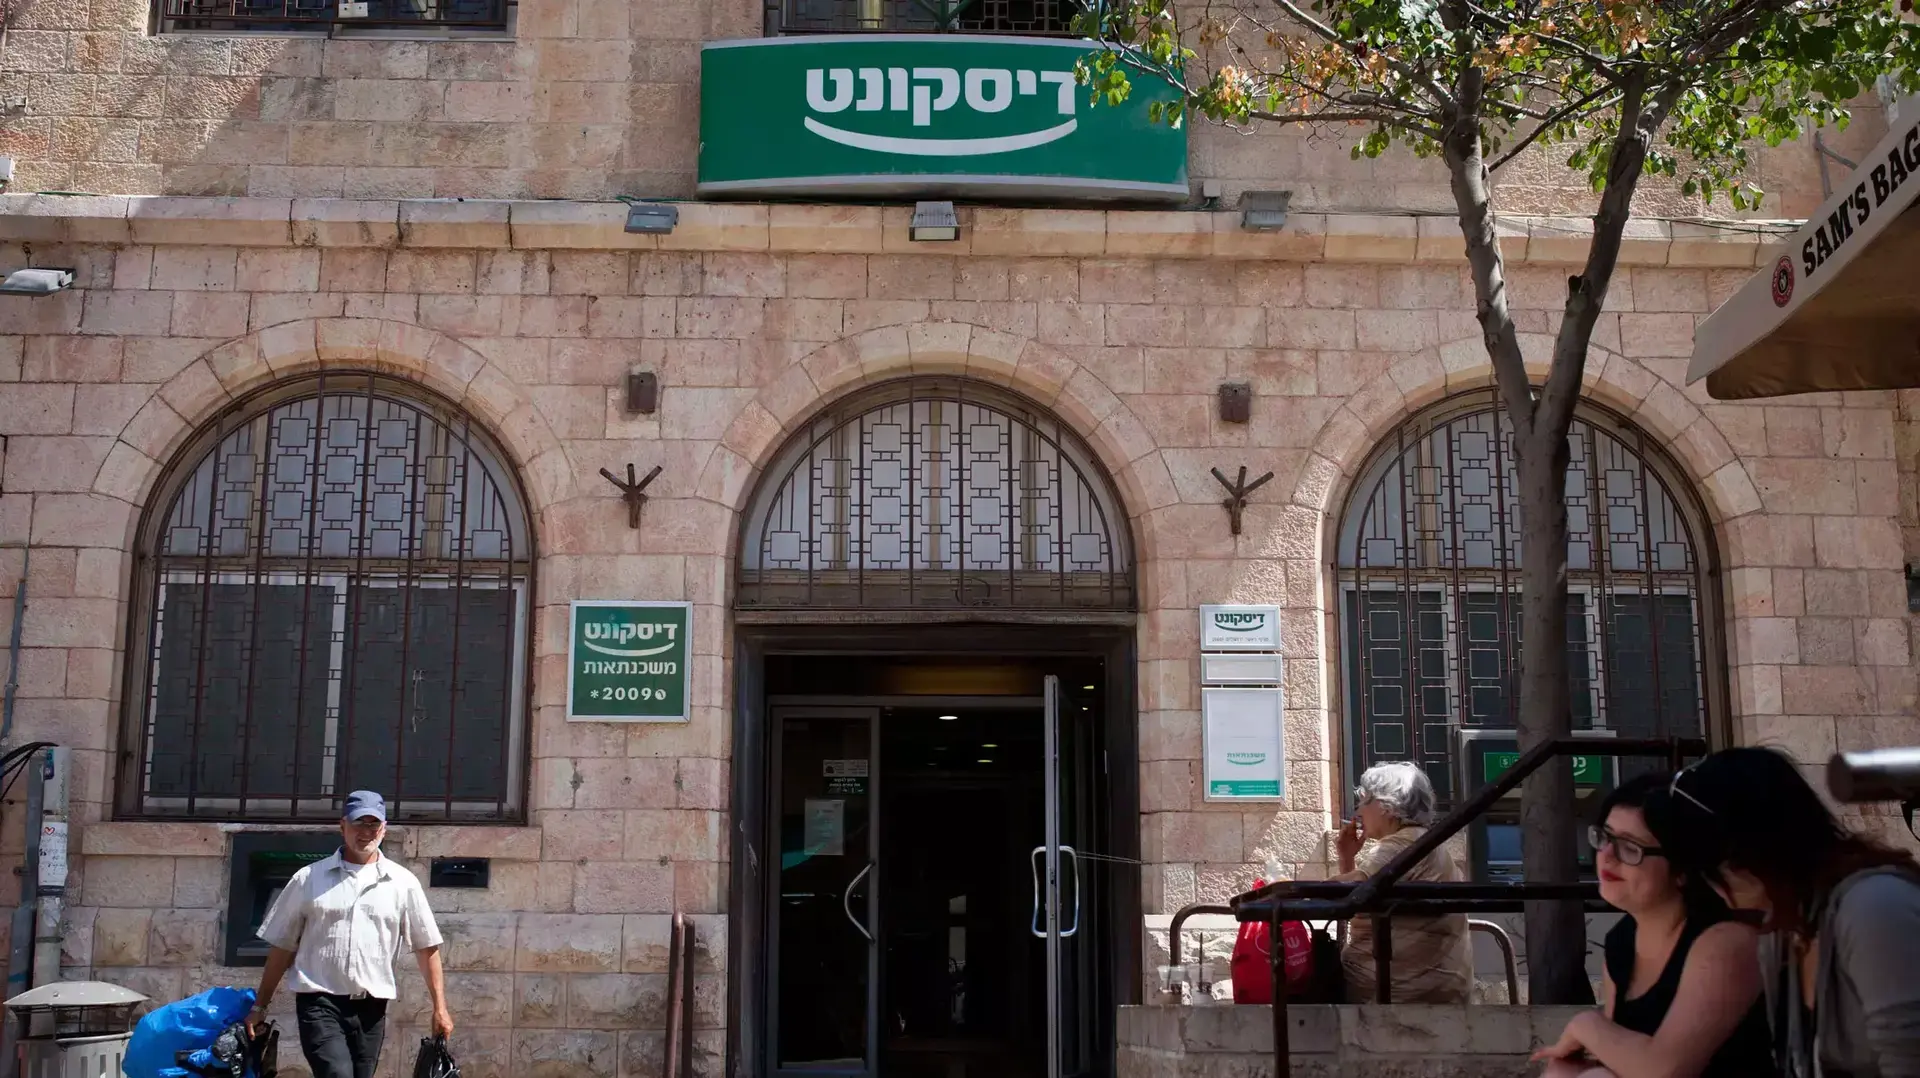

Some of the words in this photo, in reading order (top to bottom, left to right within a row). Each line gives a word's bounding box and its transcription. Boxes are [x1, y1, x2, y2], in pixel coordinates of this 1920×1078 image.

[806, 67, 1077, 126] דיסקונט
[1802, 182, 1870, 278] SAM'S
[1870, 120, 1920, 209] BAG
[1214, 613, 1265, 626] דיסקונט
[584, 622, 678, 645] דיסקונט
[583, 661, 677, 675] משכנתאות
